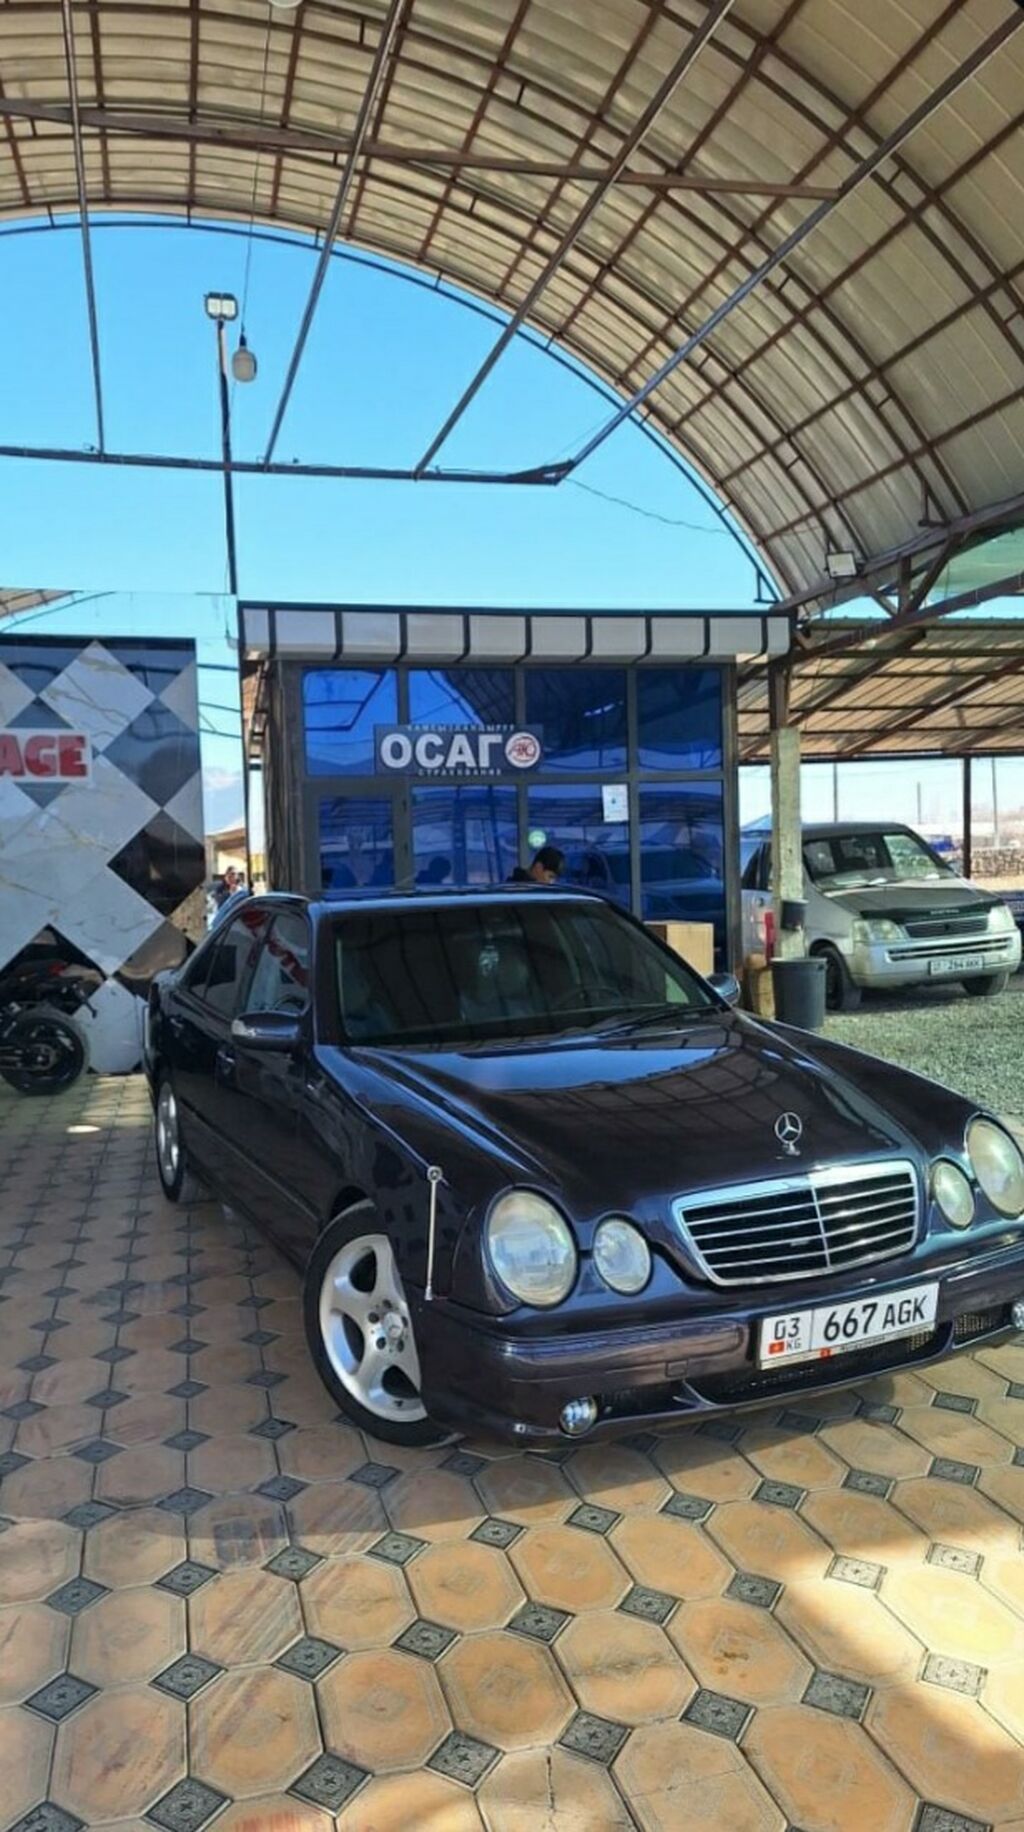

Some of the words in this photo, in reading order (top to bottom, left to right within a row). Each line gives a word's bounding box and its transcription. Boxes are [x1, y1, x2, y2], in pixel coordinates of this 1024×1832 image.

[774, 1317, 800, 1341] 03
[824, 1302, 878, 1342] 667
[882, 1295, 928, 1330] AGK
[786, 1337, 802, 1350] KG
